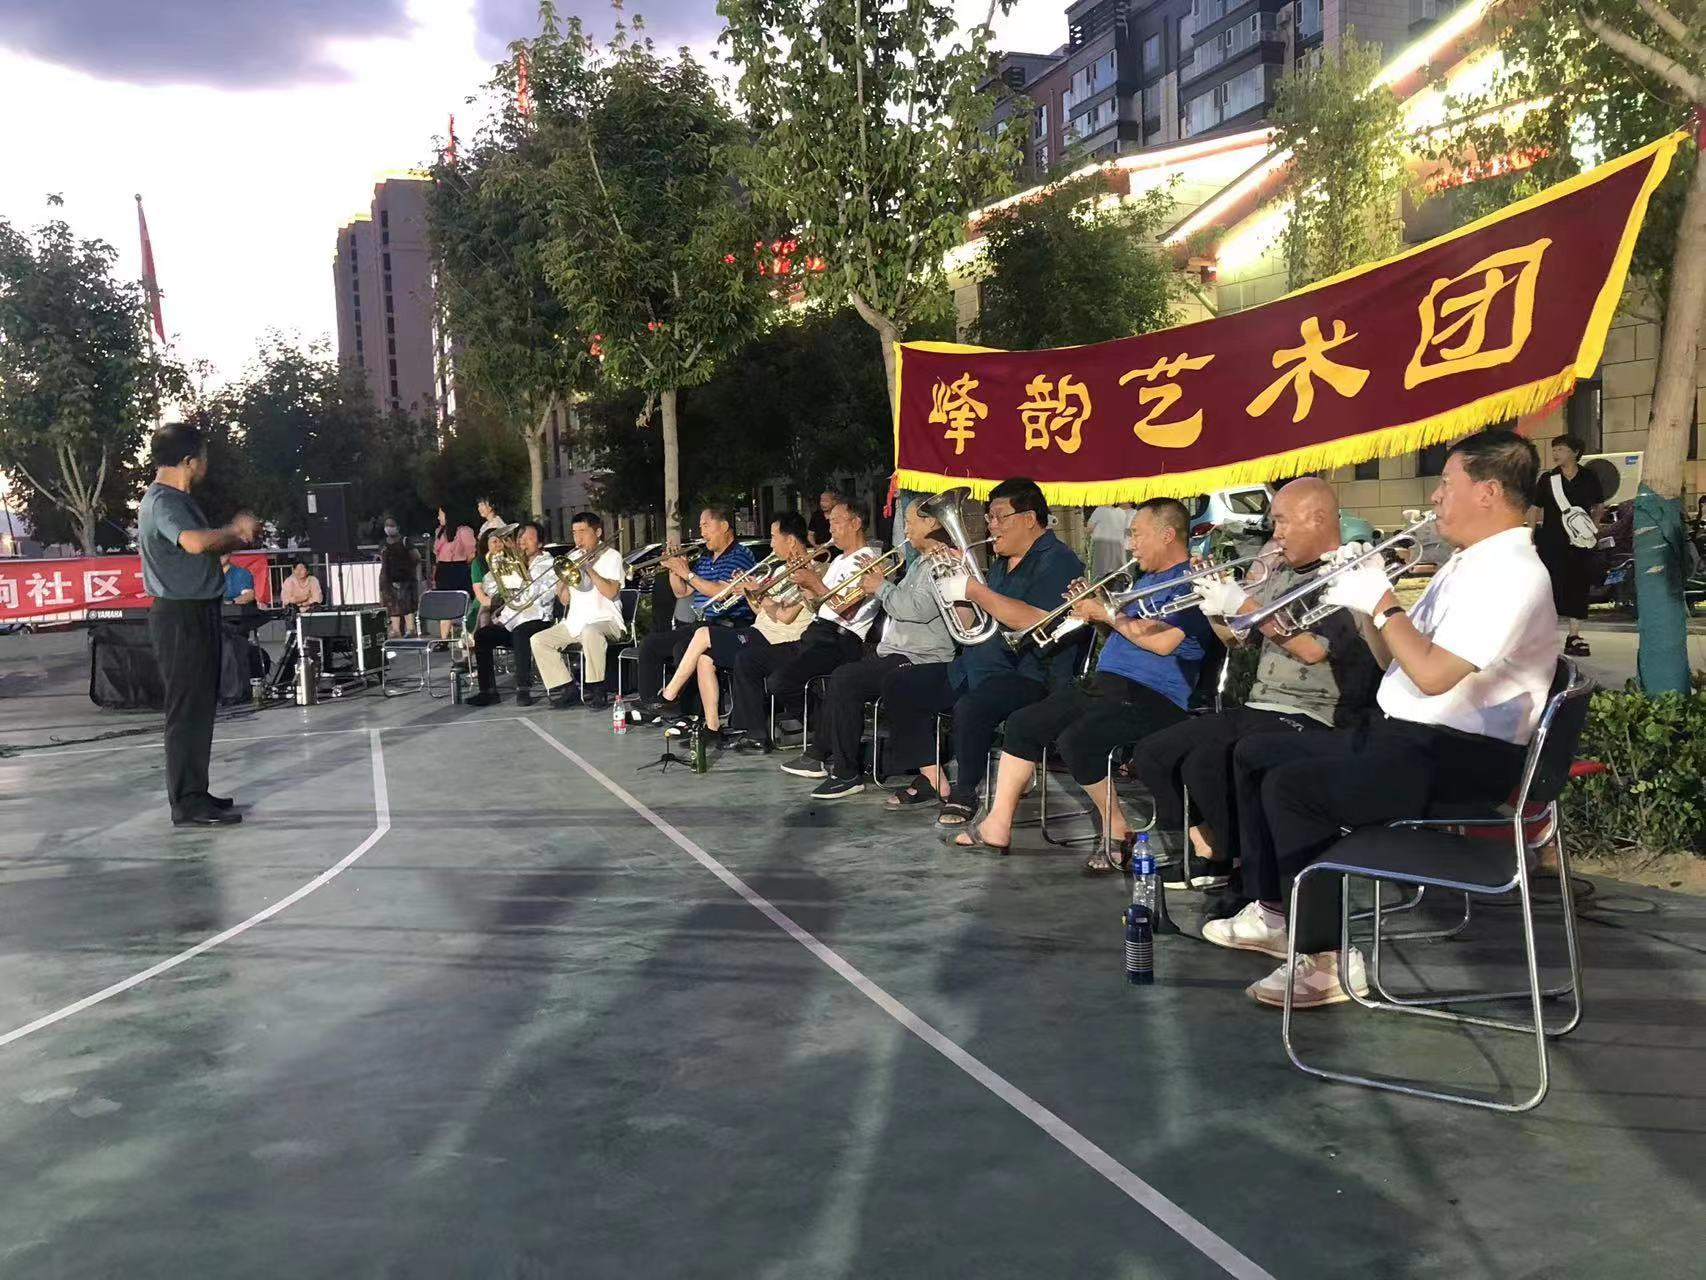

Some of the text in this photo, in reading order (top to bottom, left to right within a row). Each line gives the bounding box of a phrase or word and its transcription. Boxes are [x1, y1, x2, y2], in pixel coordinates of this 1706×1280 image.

[928, 237, 1552, 455] 峰韵艺术团
[97, 610, 123, 619] YAMAHA
